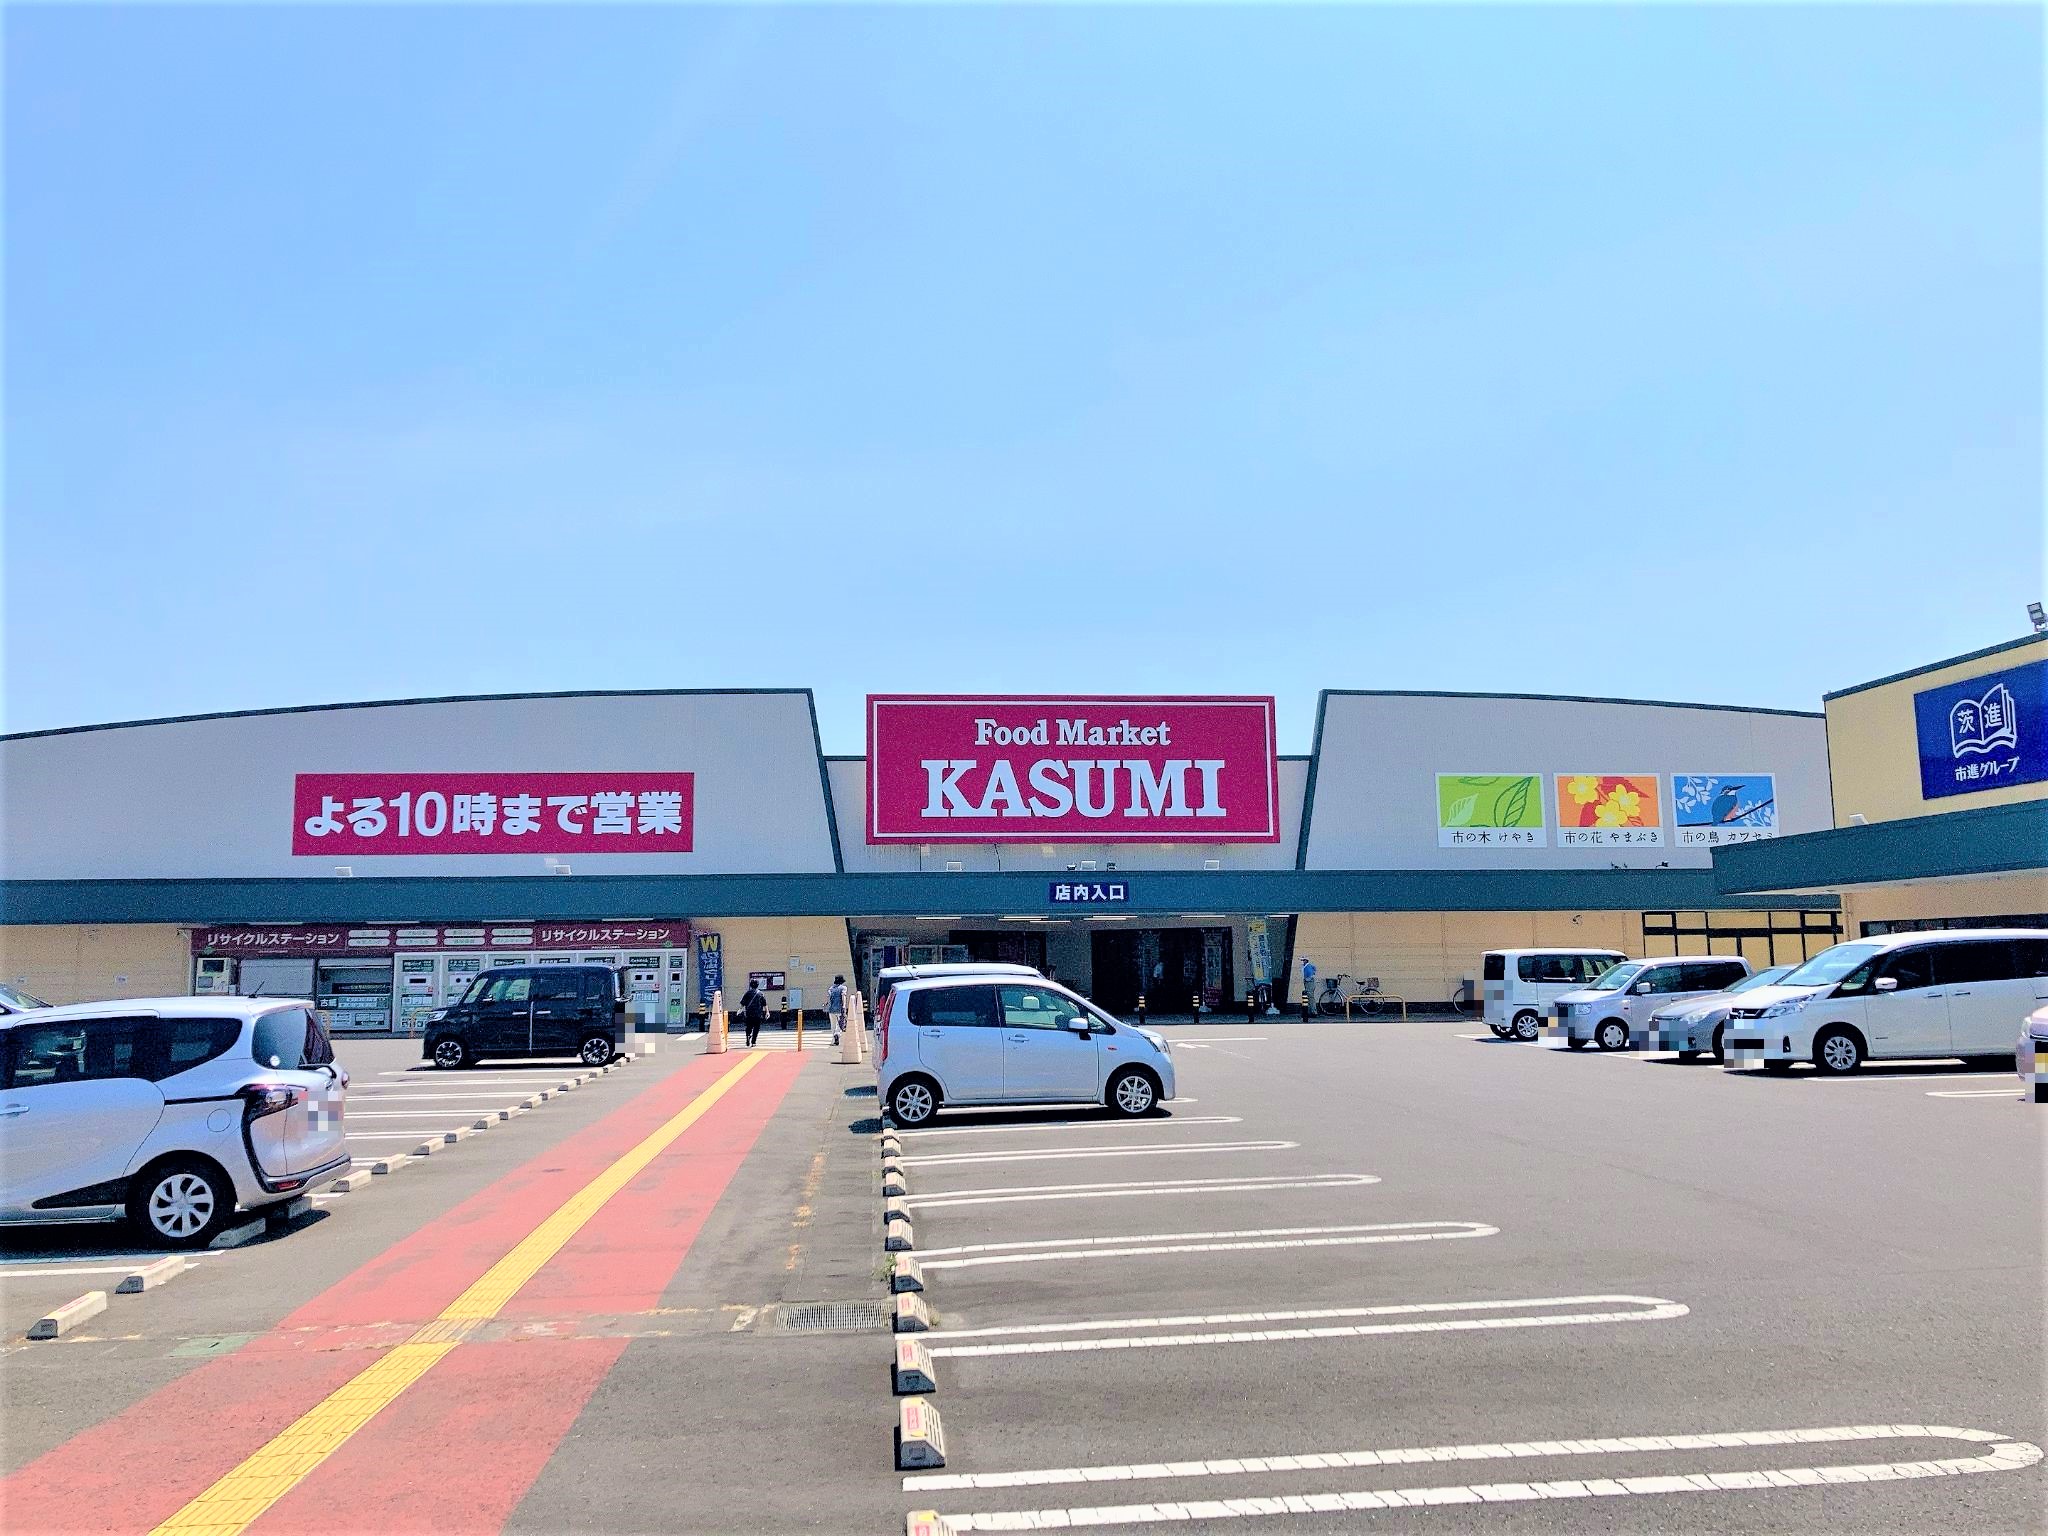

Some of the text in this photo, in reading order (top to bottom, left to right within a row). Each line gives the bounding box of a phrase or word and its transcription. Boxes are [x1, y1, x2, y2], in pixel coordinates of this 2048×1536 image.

[975, 718, 1172, 746] Food Market
[1955, 757, 2020, 782] 市進グループ
[920, 758, 1227, 818] KASUMI
[304, 790, 683, 837] よる10時まで営業
[1452, 831, 1534, 844] 市の木 けやき
[1564, 831, 1659, 844] 市の花 やまぶき
[1055, 884, 1125, 901] 店内入口
[207, 932, 340, 946] リサイクルステーション
[541, 928, 671, 942] リサイクルステーション
